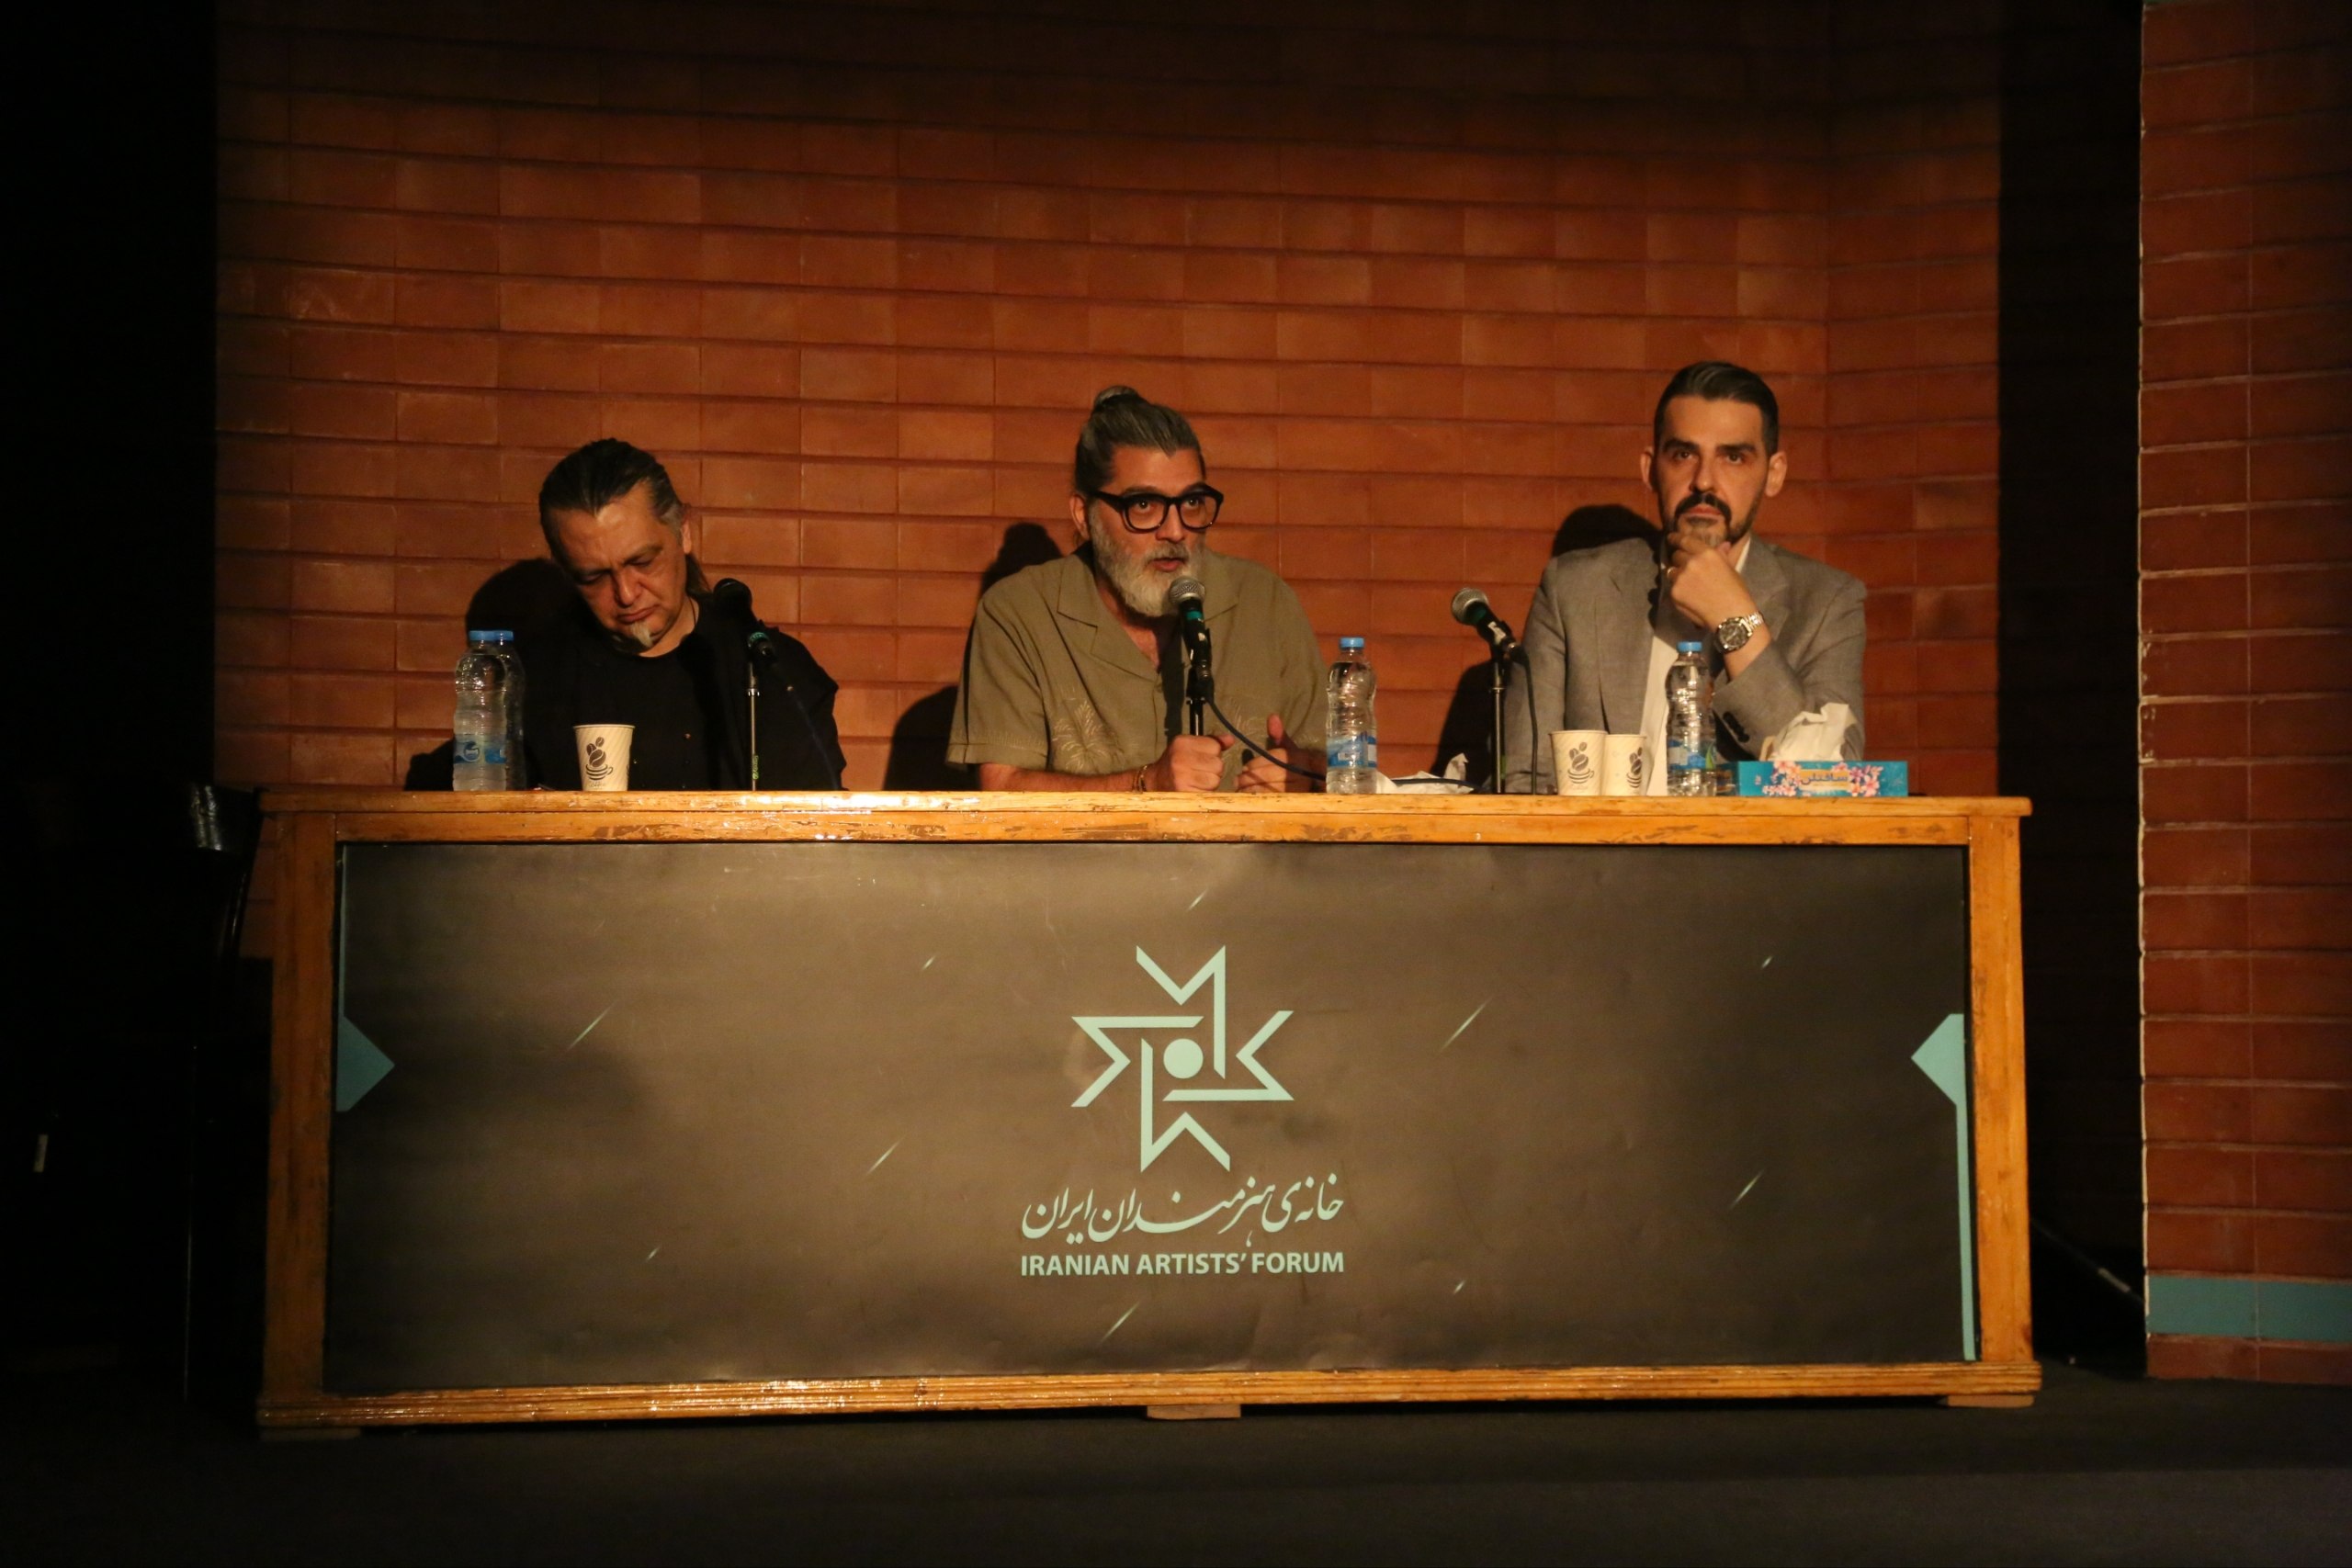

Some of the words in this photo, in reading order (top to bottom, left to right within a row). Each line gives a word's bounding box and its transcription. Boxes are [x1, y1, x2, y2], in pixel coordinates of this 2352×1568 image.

[1022, 1187, 1094, 1245] ایران
[1088, 1176, 1276, 1247] هنرمندان
[1021, 1254, 1129, 1276] IRANIAN
[1251, 1251, 1344, 1274] FORUM
